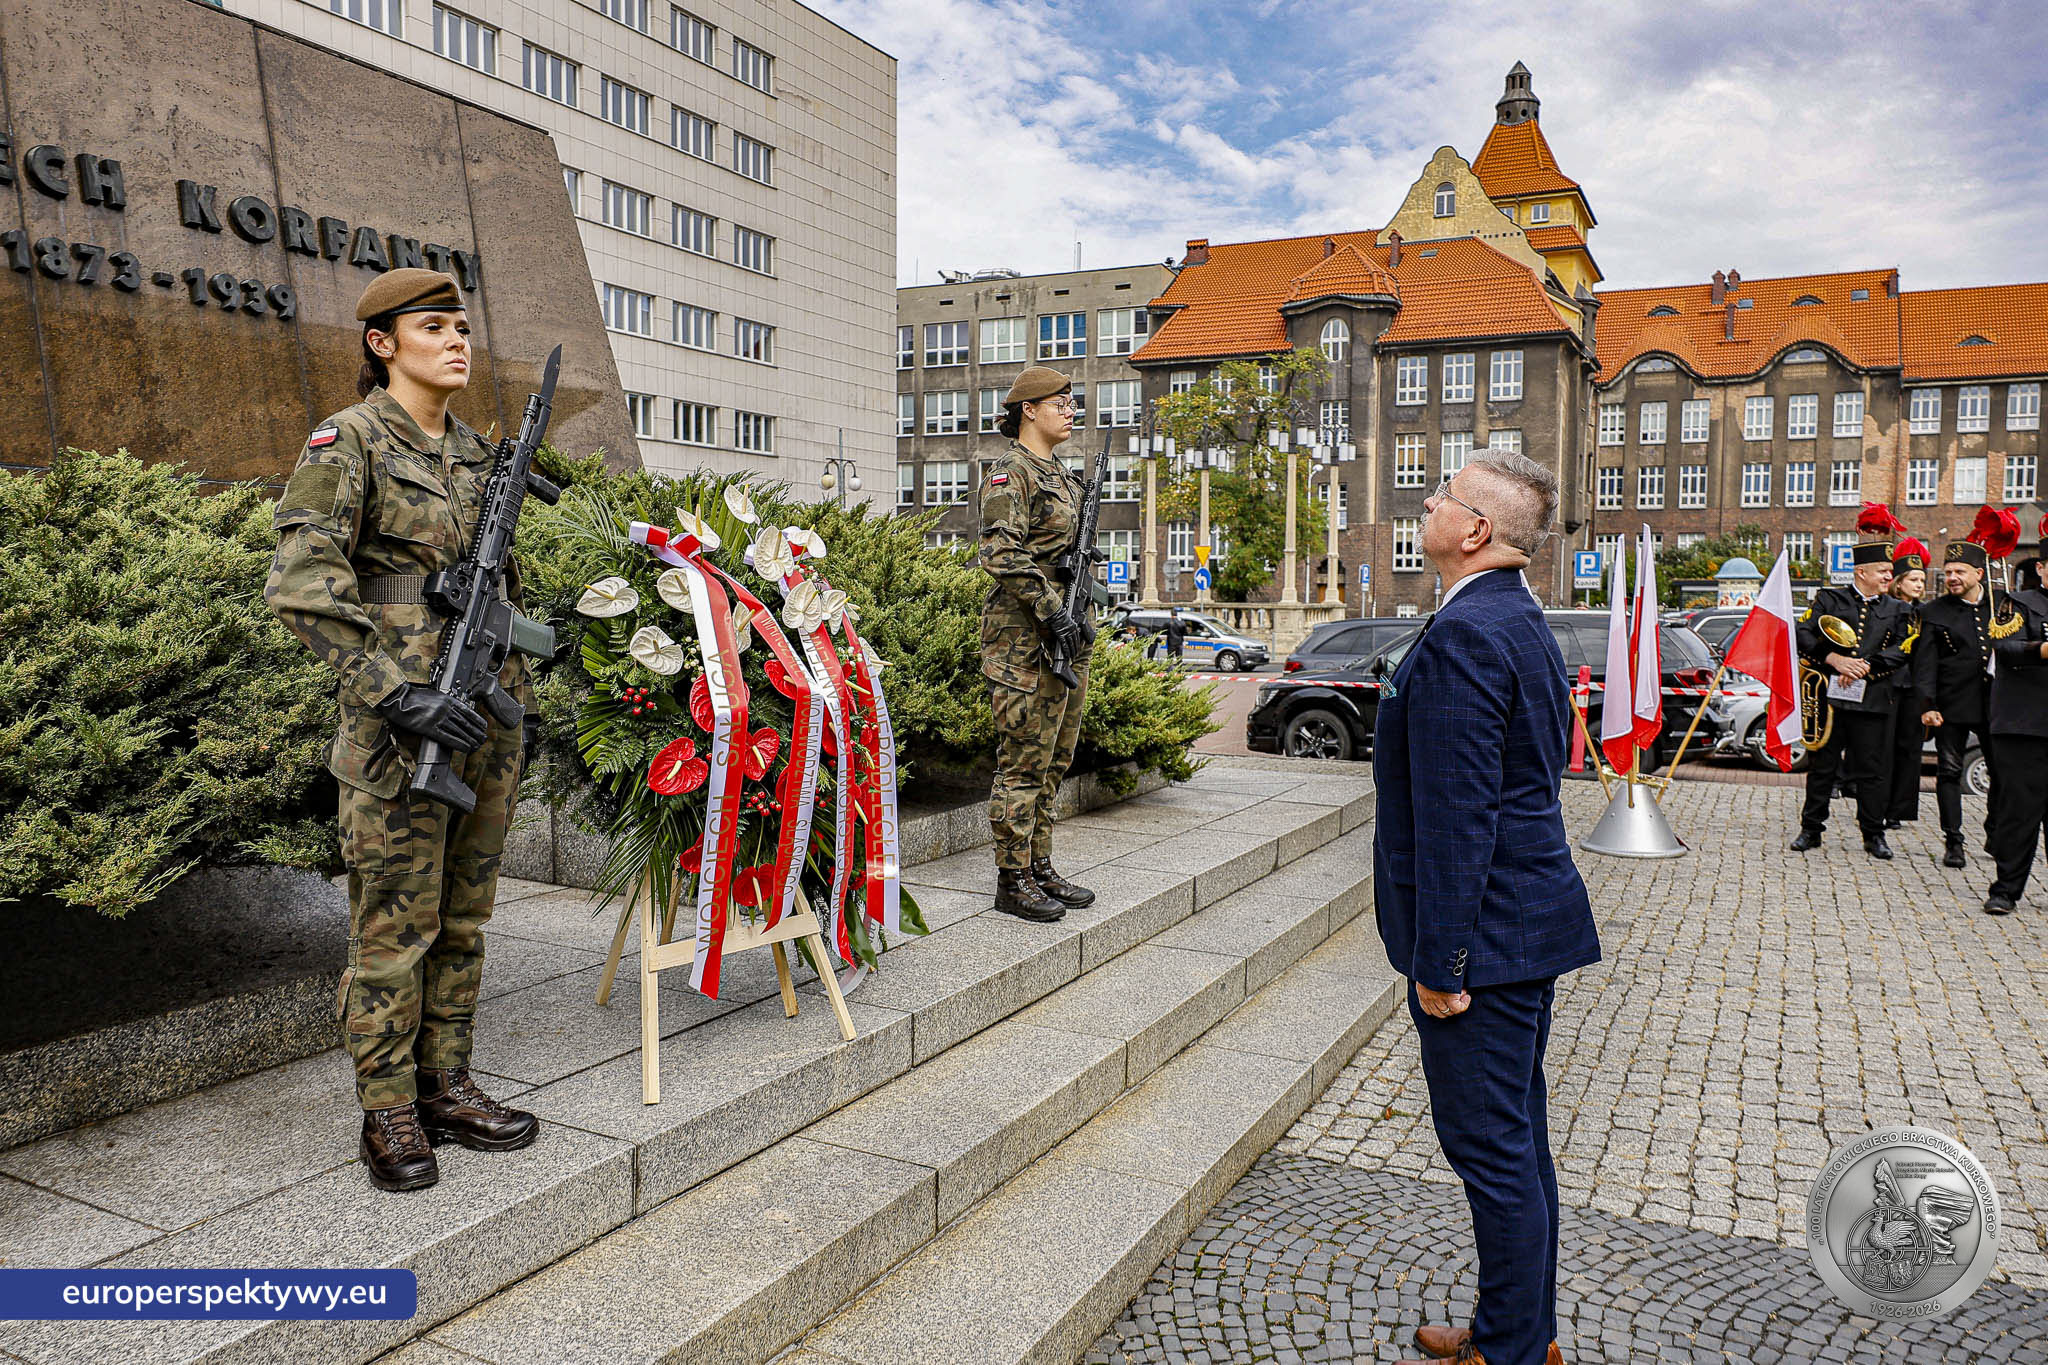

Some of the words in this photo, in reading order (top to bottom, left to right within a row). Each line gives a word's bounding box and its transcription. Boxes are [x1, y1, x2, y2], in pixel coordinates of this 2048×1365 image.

[0, 229, 297, 321] 1873-1939
[175, 179, 481, 292] KORFANTY
[1111, 563, 1124, 582] P
[1580, 554, 1596, 575] P
[1838, 547, 1854, 570] P
[707, 648, 742, 767] SAŁUGA
[698, 795, 735, 953] WOJCIECH
[831, 766, 853, 917] WOJCIECHOWI
